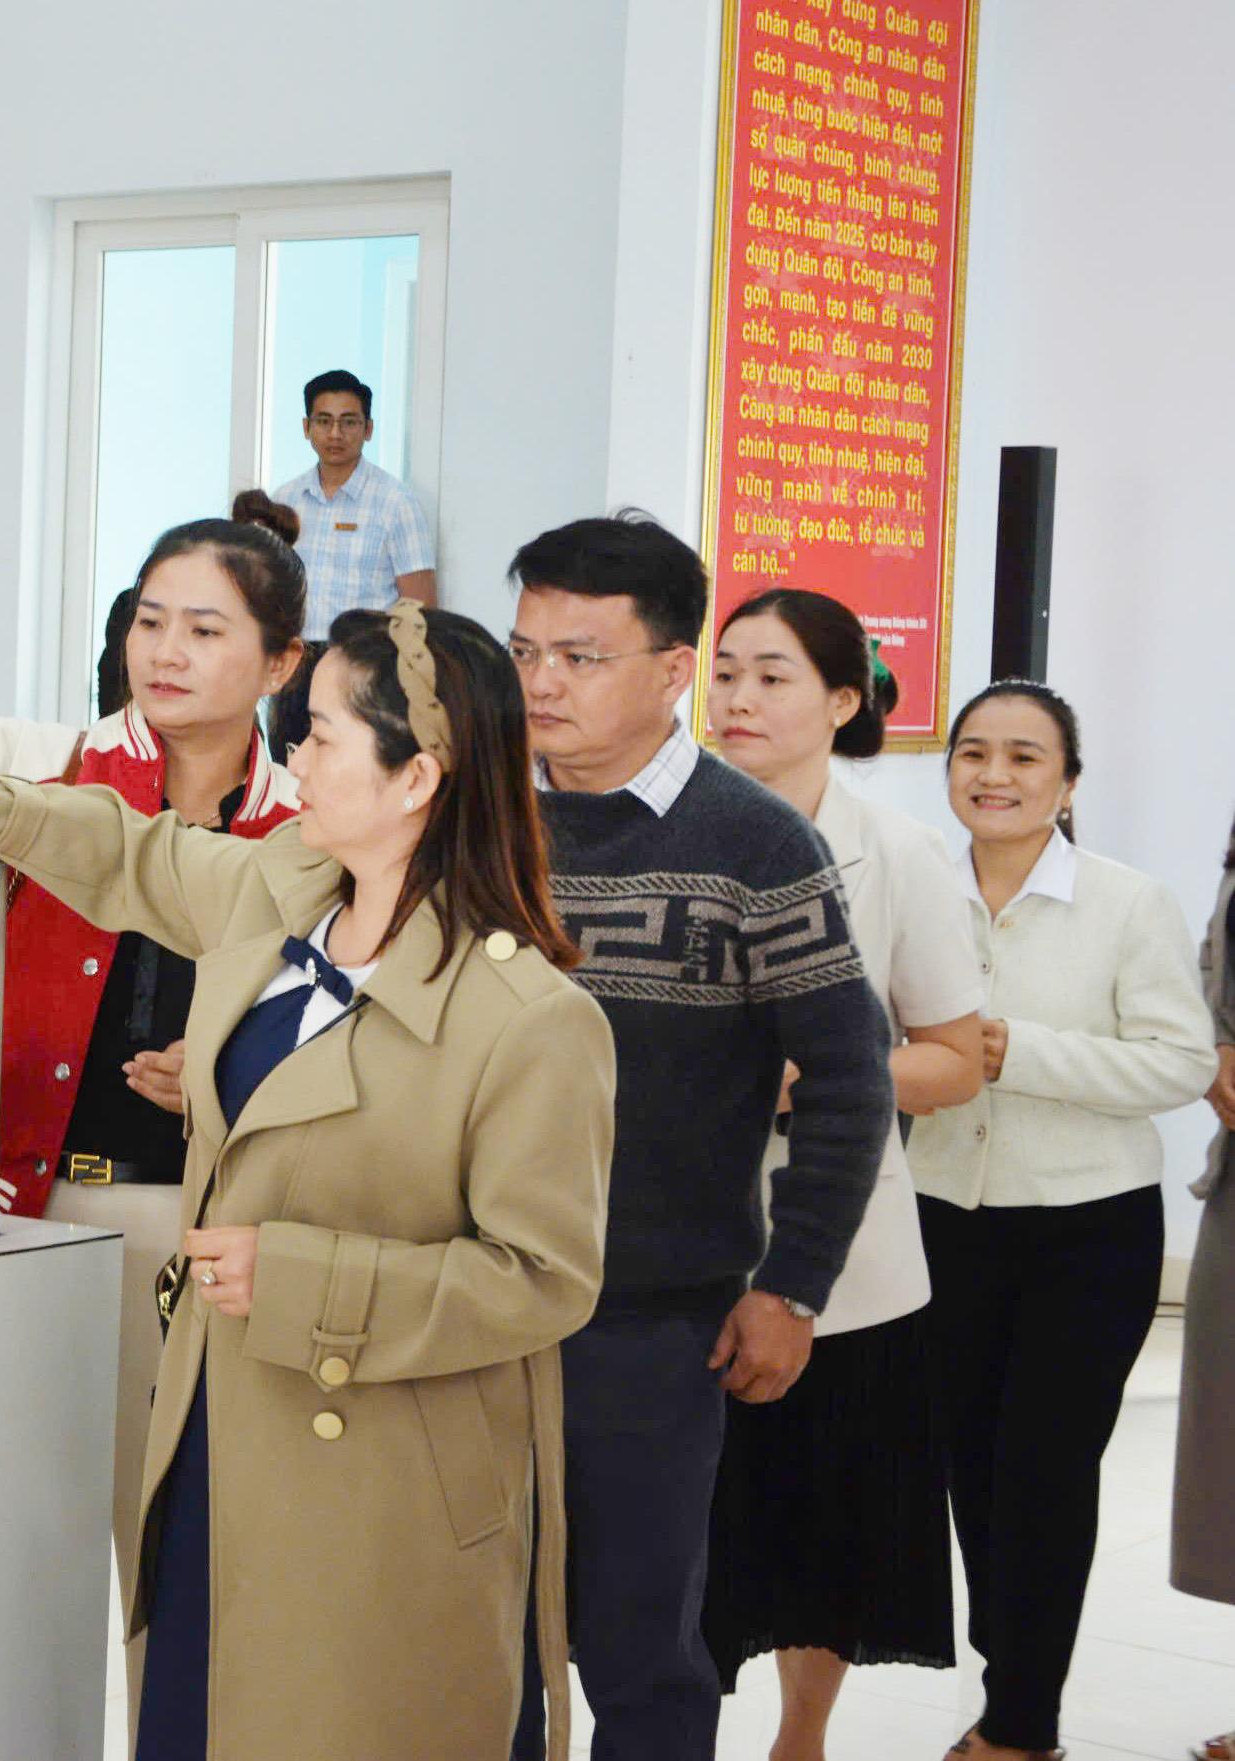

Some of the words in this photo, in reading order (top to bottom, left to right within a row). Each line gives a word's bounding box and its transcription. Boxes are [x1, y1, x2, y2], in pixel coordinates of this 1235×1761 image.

[828, 27, 862, 64] Công
[867, 44, 882, 64] an
[928, 18, 949, 48] đội
[751, 122, 769, 149] số
[749, 162, 769, 192] lực
[888, 193, 906, 219] lên
[912, 198, 938, 229] hiện
[775, 205, 800, 233] Đến
[871, 231, 887, 252] cơ
[890, 229, 912, 257] bản
[916, 238, 938, 267] xây
[745, 241, 779, 275] dựng
[784, 247, 818, 276] Quân
[823, 256, 846, 286] đội,
[851, 260, 884, 295] Công
[889, 273, 903, 292] an
[744, 284, 773, 310] gọn,
[780, 288, 820, 319] mạnh,
[826, 294, 846, 324] tạo
[904, 309, 934, 340] vững
[742, 315, 779, 350] chắc,
[789, 324, 823, 354] phấn
[832, 330, 857, 358] đấu
[901, 344, 932, 370] 2030
[741, 357, 764, 387] xây
[768, 361, 802, 394] dựng
[807, 365, 840, 393] Quân
[845, 371, 864, 400] đội
[869, 375, 899, 401] nhân
[904, 379, 930, 410] dân,
[740, 394, 774, 428] Công
[779, 405, 793, 425] an
[798, 403, 830, 429] nhân
[834, 407, 858, 433] dân
[861, 412, 890, 437] cách
[837, 446, 871, 476] nhuệ,
[875, 449, 901, 479] hiện
[736, 472, 772, 504] vững
[783, 478, 822, 506] mạnh
[735, 511, 749, 534] tư
[799, 515, 823, 544] đạo
[859, 515, 873, 543] tổ
